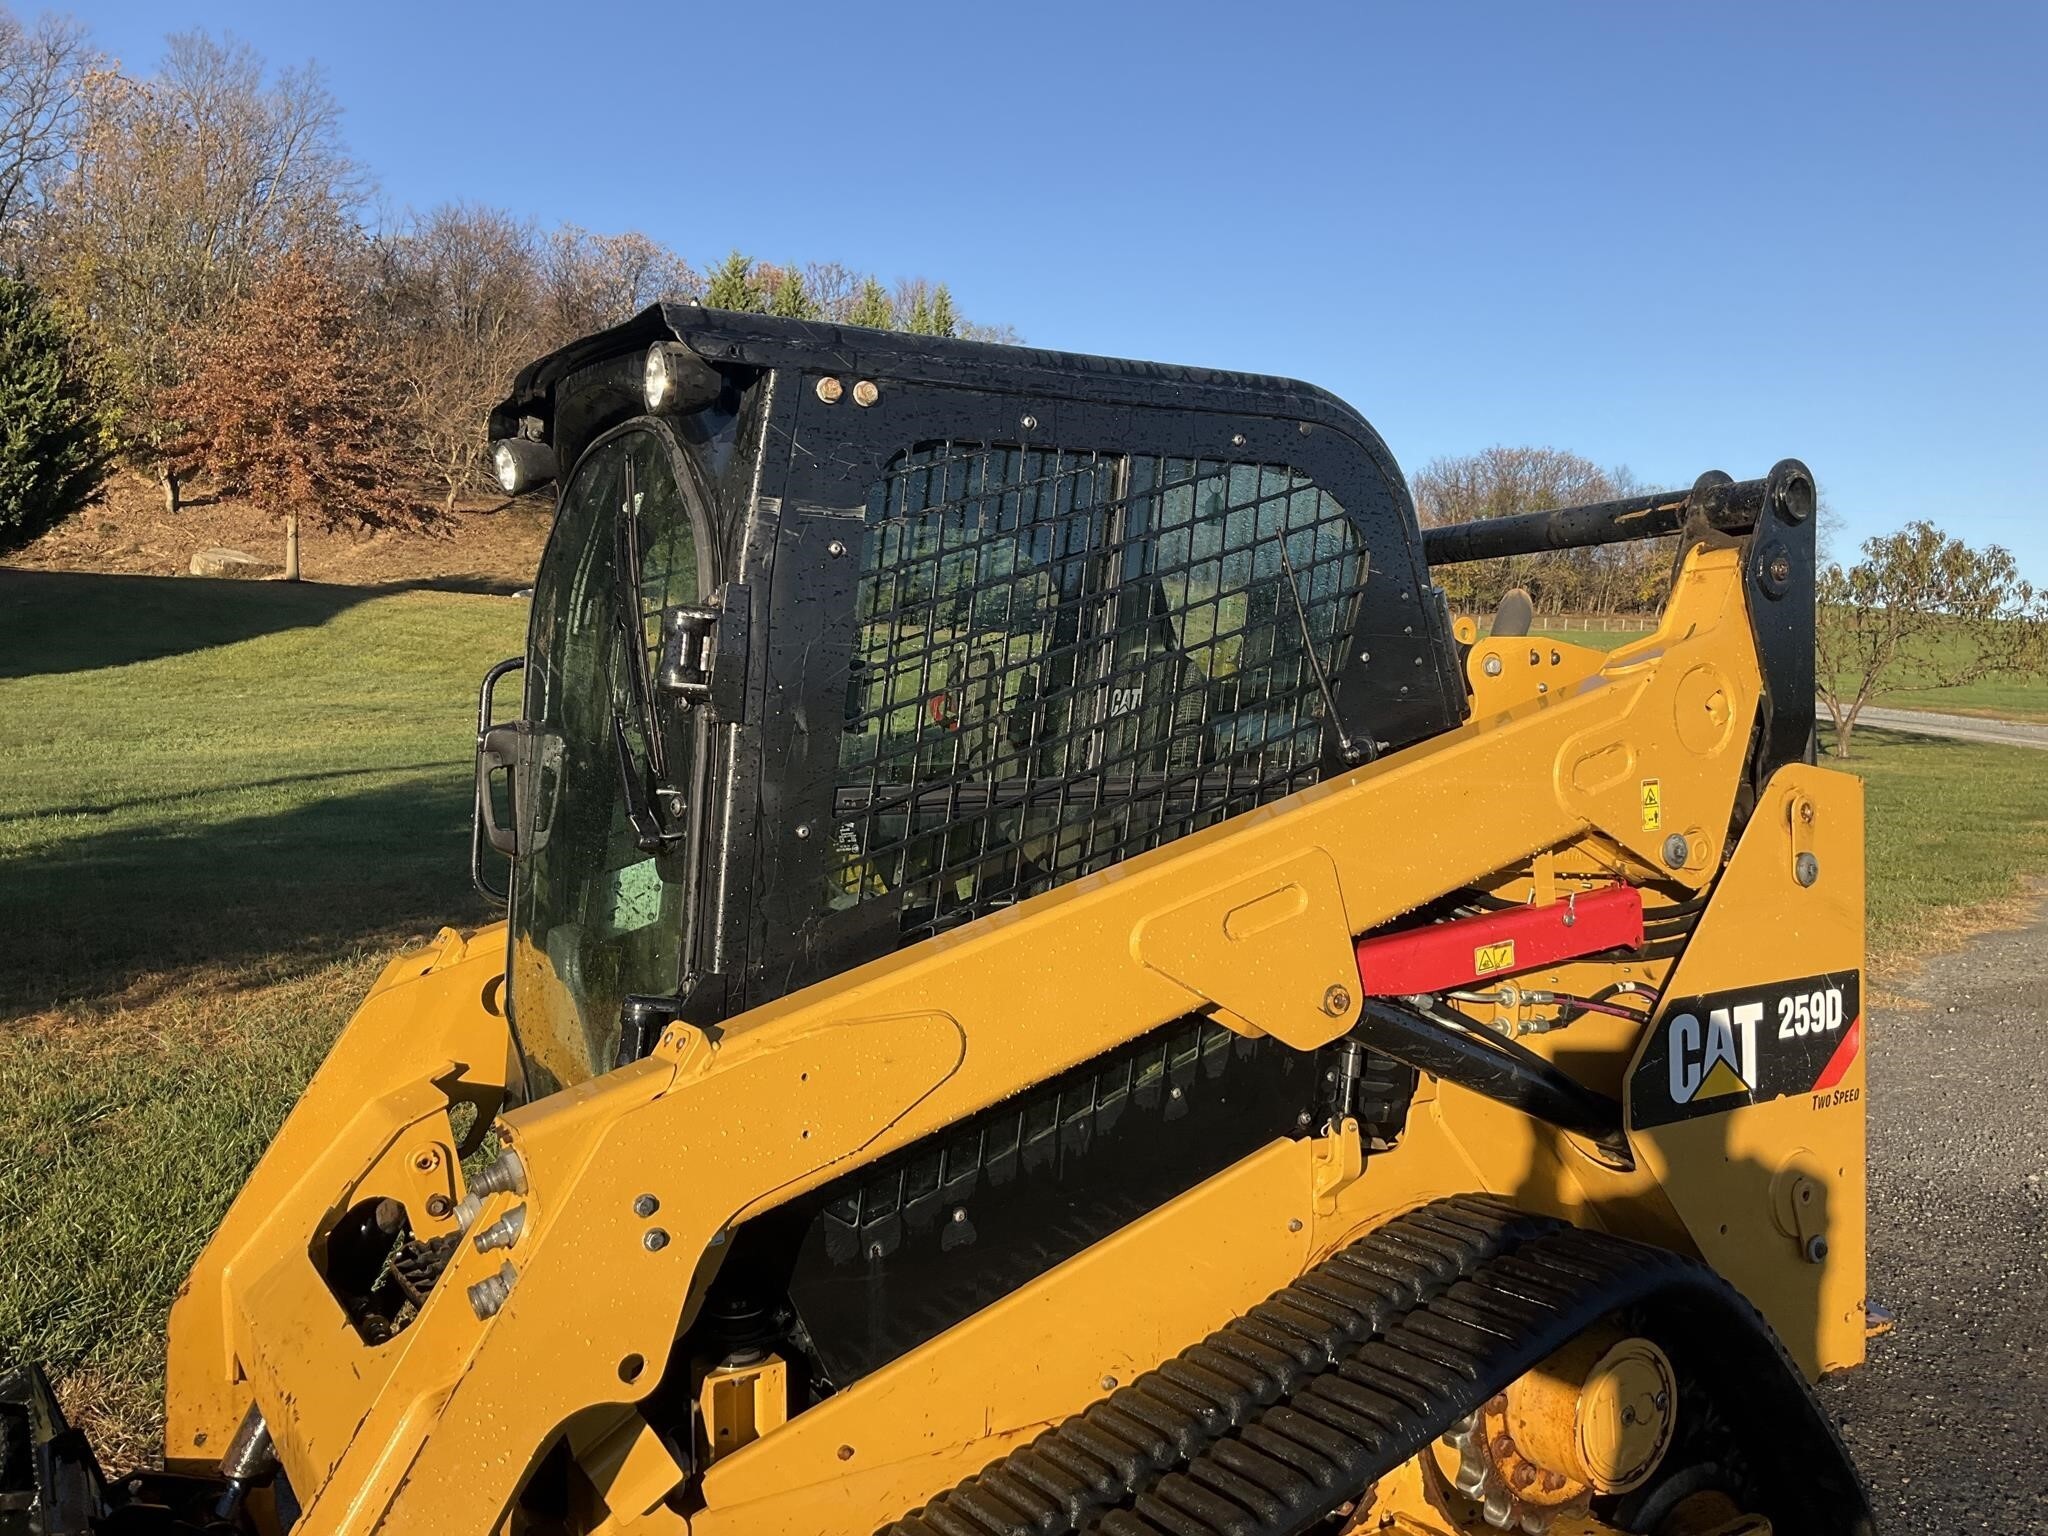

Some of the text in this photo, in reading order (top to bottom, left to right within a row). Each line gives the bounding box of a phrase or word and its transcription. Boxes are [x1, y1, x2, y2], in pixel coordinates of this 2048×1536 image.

[1111, 688, 1141, 717] CAT
[1669, 989, 1842, 1104] CAT 259D
